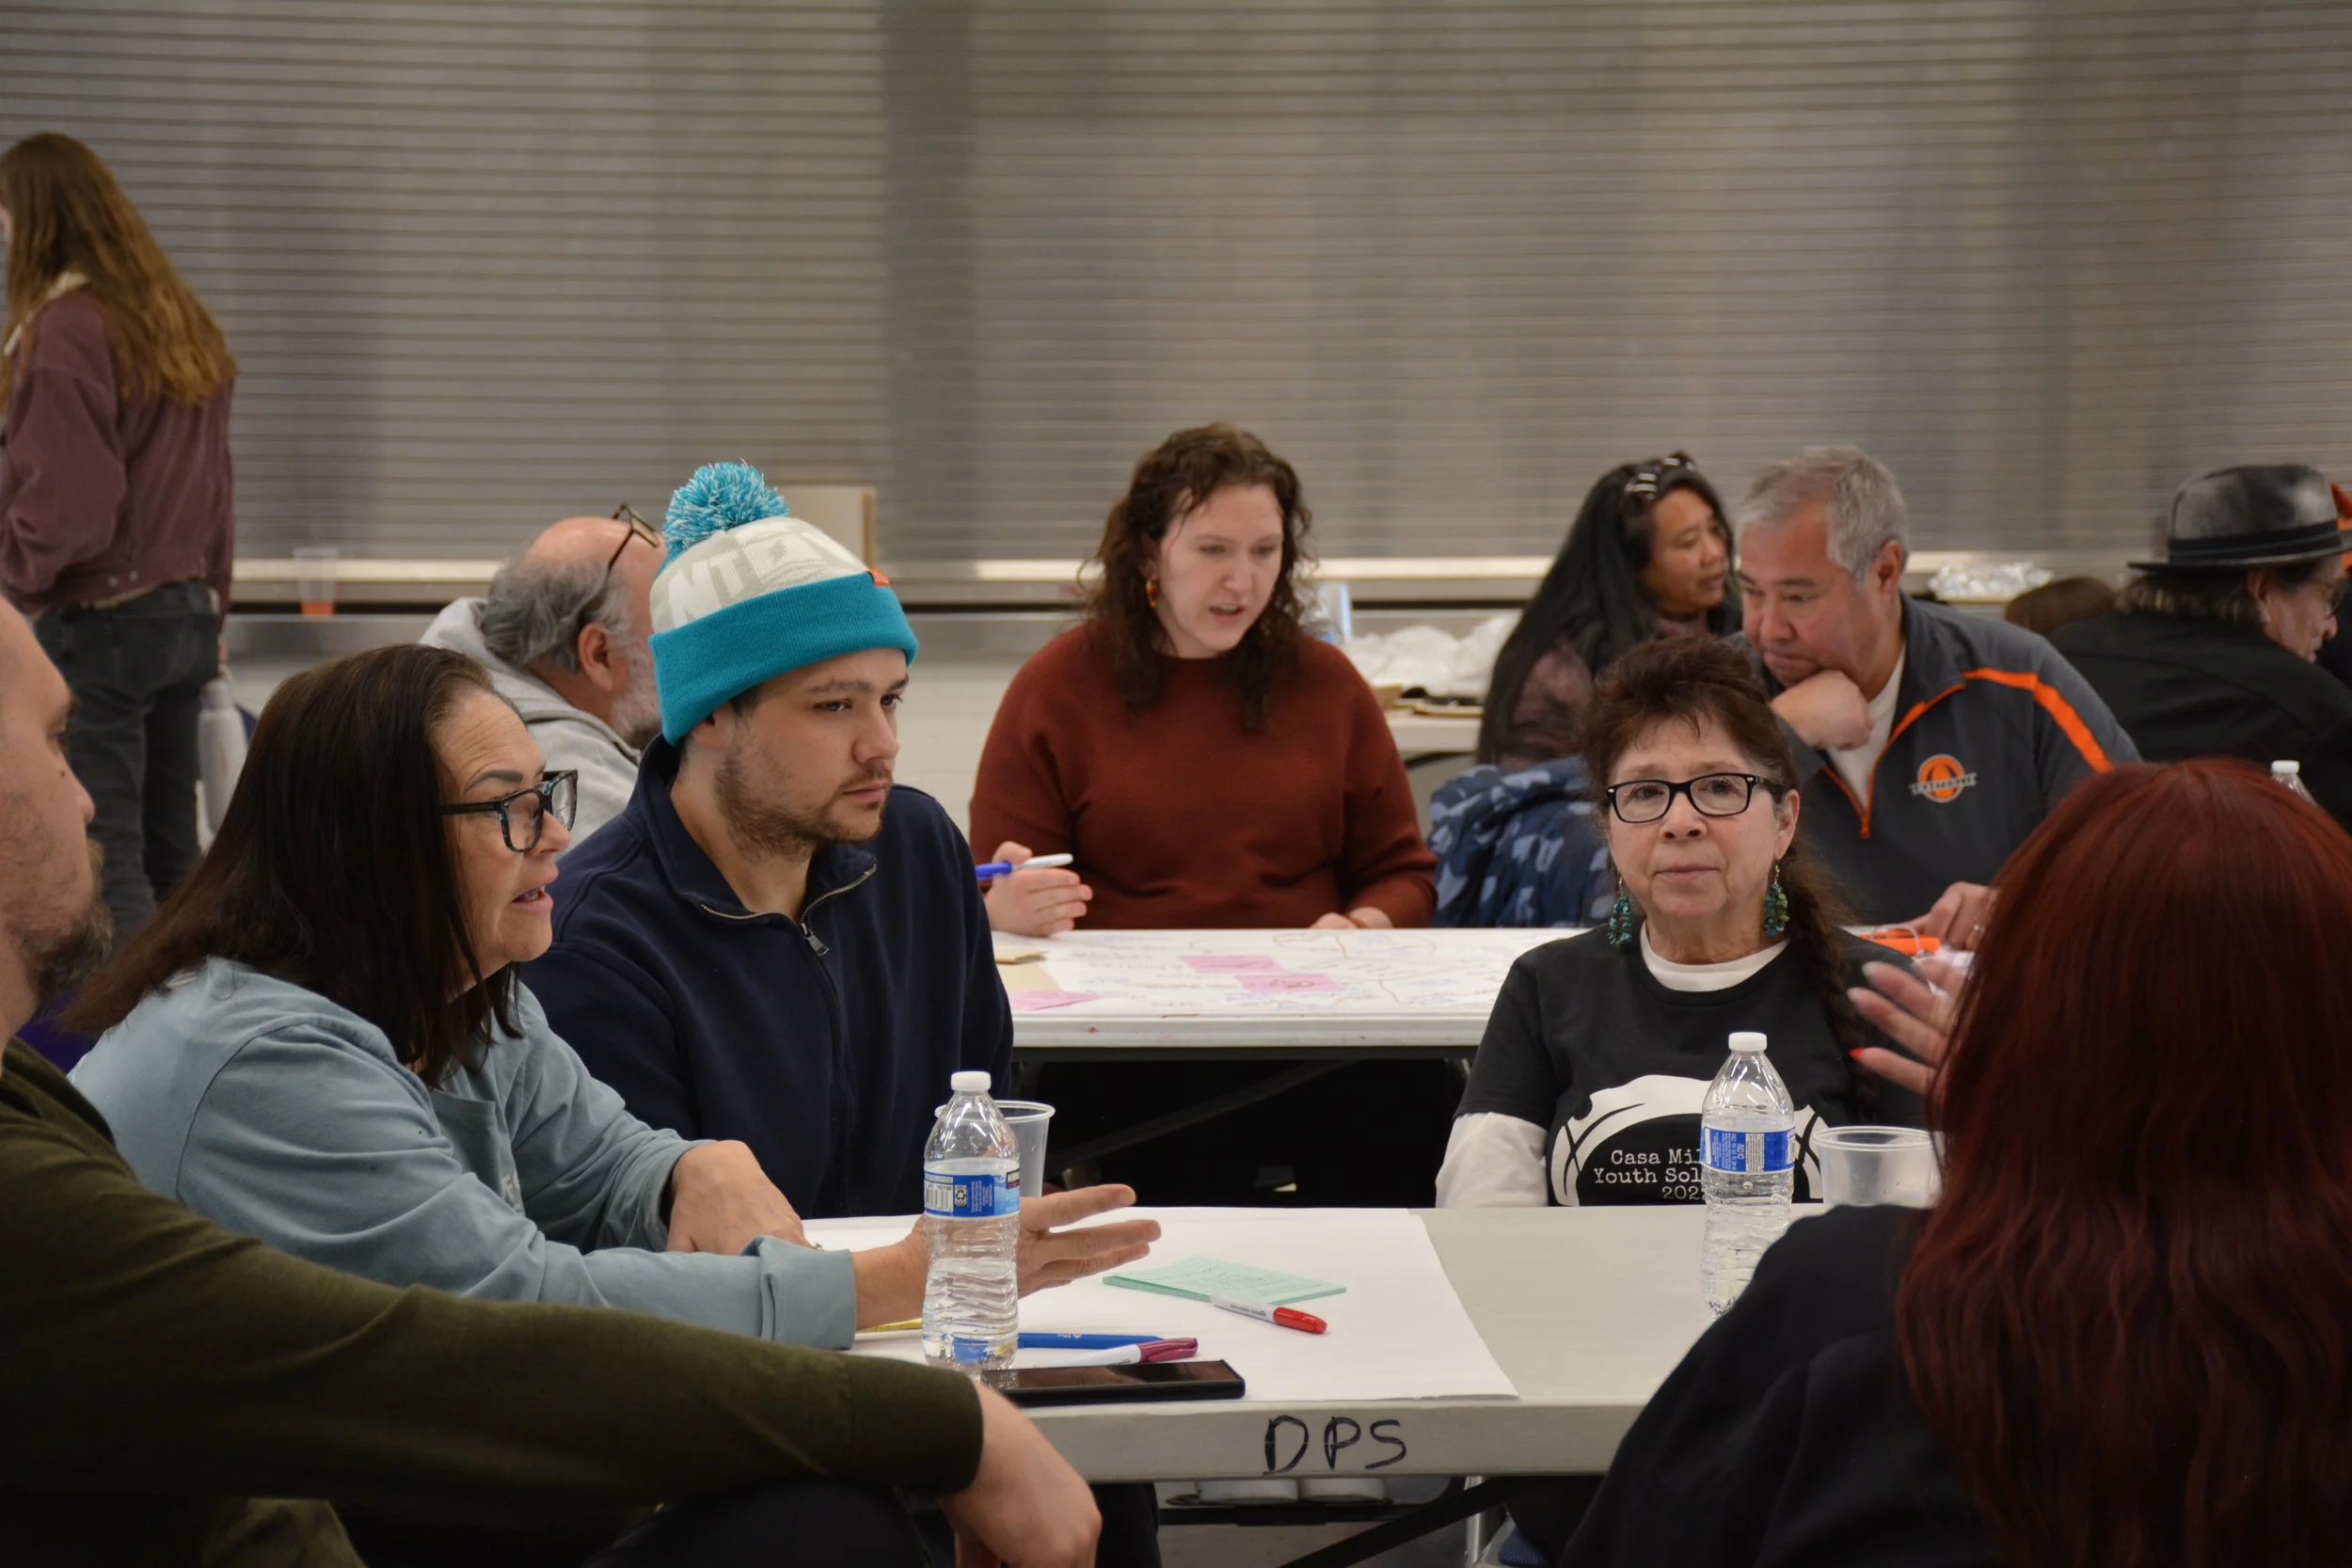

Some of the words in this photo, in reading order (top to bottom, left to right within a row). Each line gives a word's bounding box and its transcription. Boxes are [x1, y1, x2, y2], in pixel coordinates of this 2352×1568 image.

[1611, 1149, 1661, 1165] Casa
[1594, 1168, 1658, 1184] Youth
[1664, 1167, 1702, 1182] Sol
[1263, 1415, 1407, 1475] DPS
